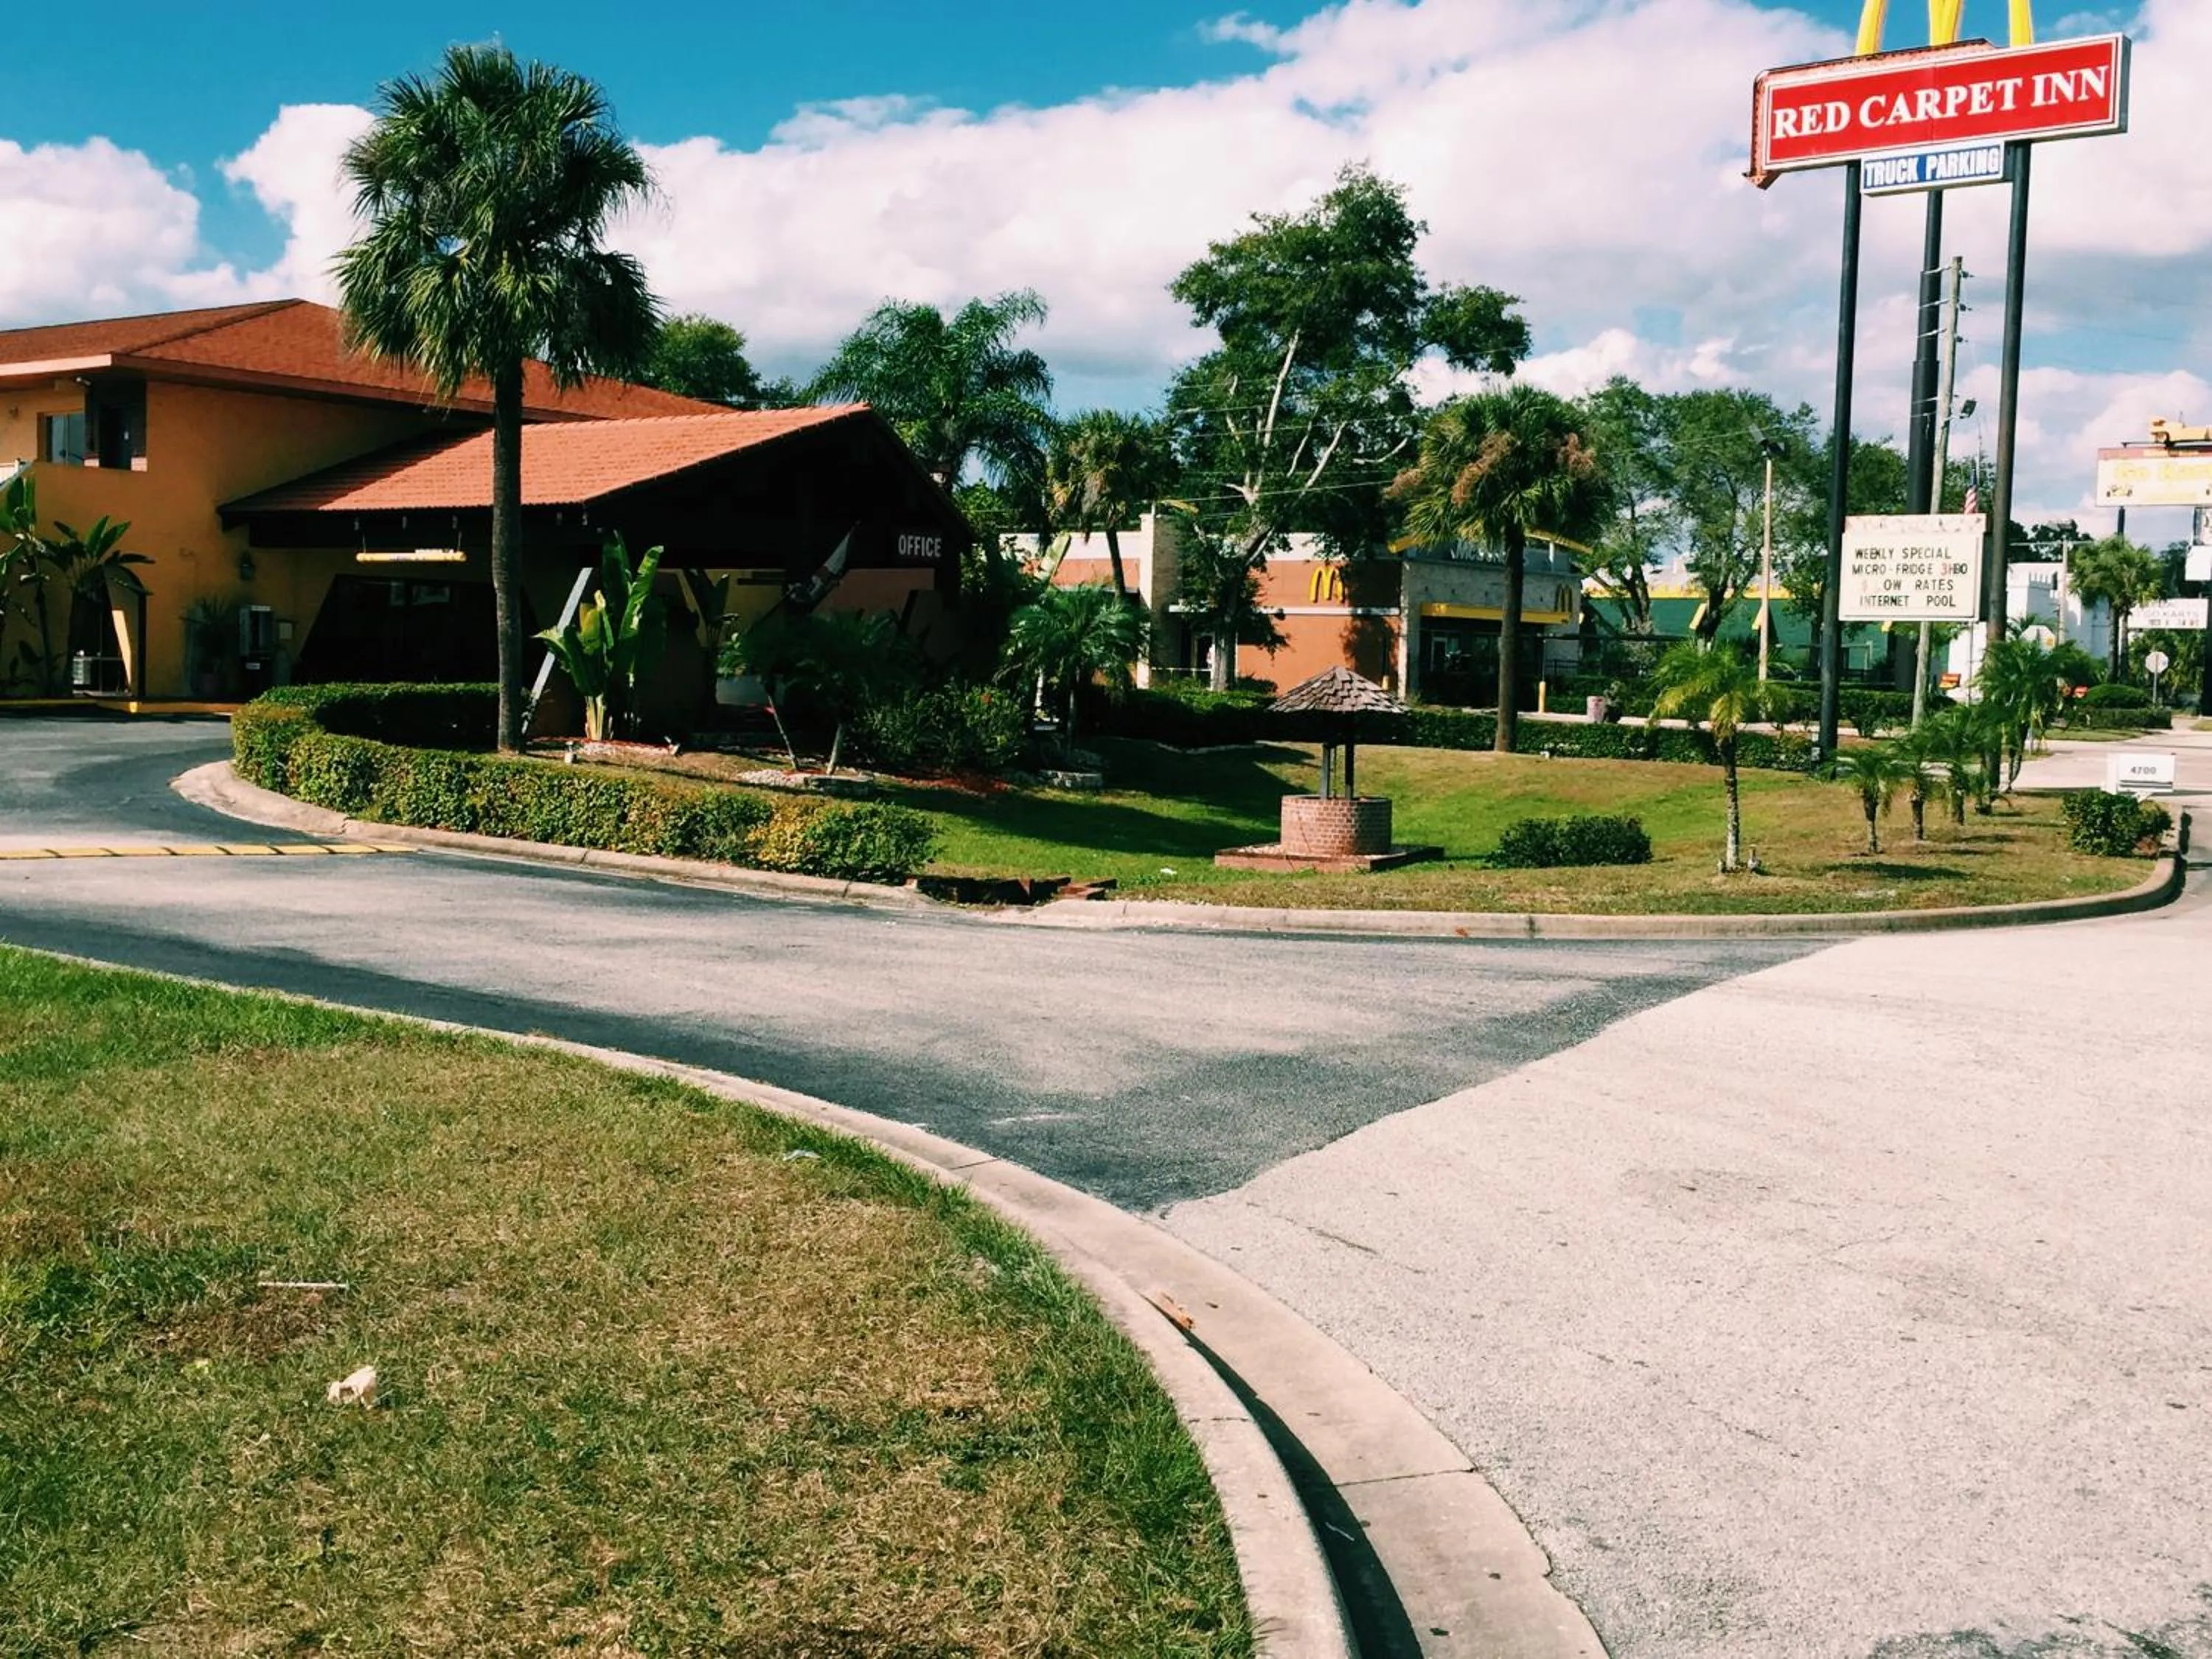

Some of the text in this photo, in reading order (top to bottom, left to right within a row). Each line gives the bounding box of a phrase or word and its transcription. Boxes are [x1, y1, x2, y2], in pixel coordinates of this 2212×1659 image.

[1773, 65, 2110, 139] RED CARPET INN
[1865, 148, 2000, 188] TRUCK PARKING
[898, 534, 942, 557] OFFICE
[1855, 548, 1951, 560] WEEKLY SPECIAL
[1915, 580, 1954, 591] RATES
[1860, 596, 1956, 607] INTERNET POOL
[2130, 766, 2157, 775] 4700
